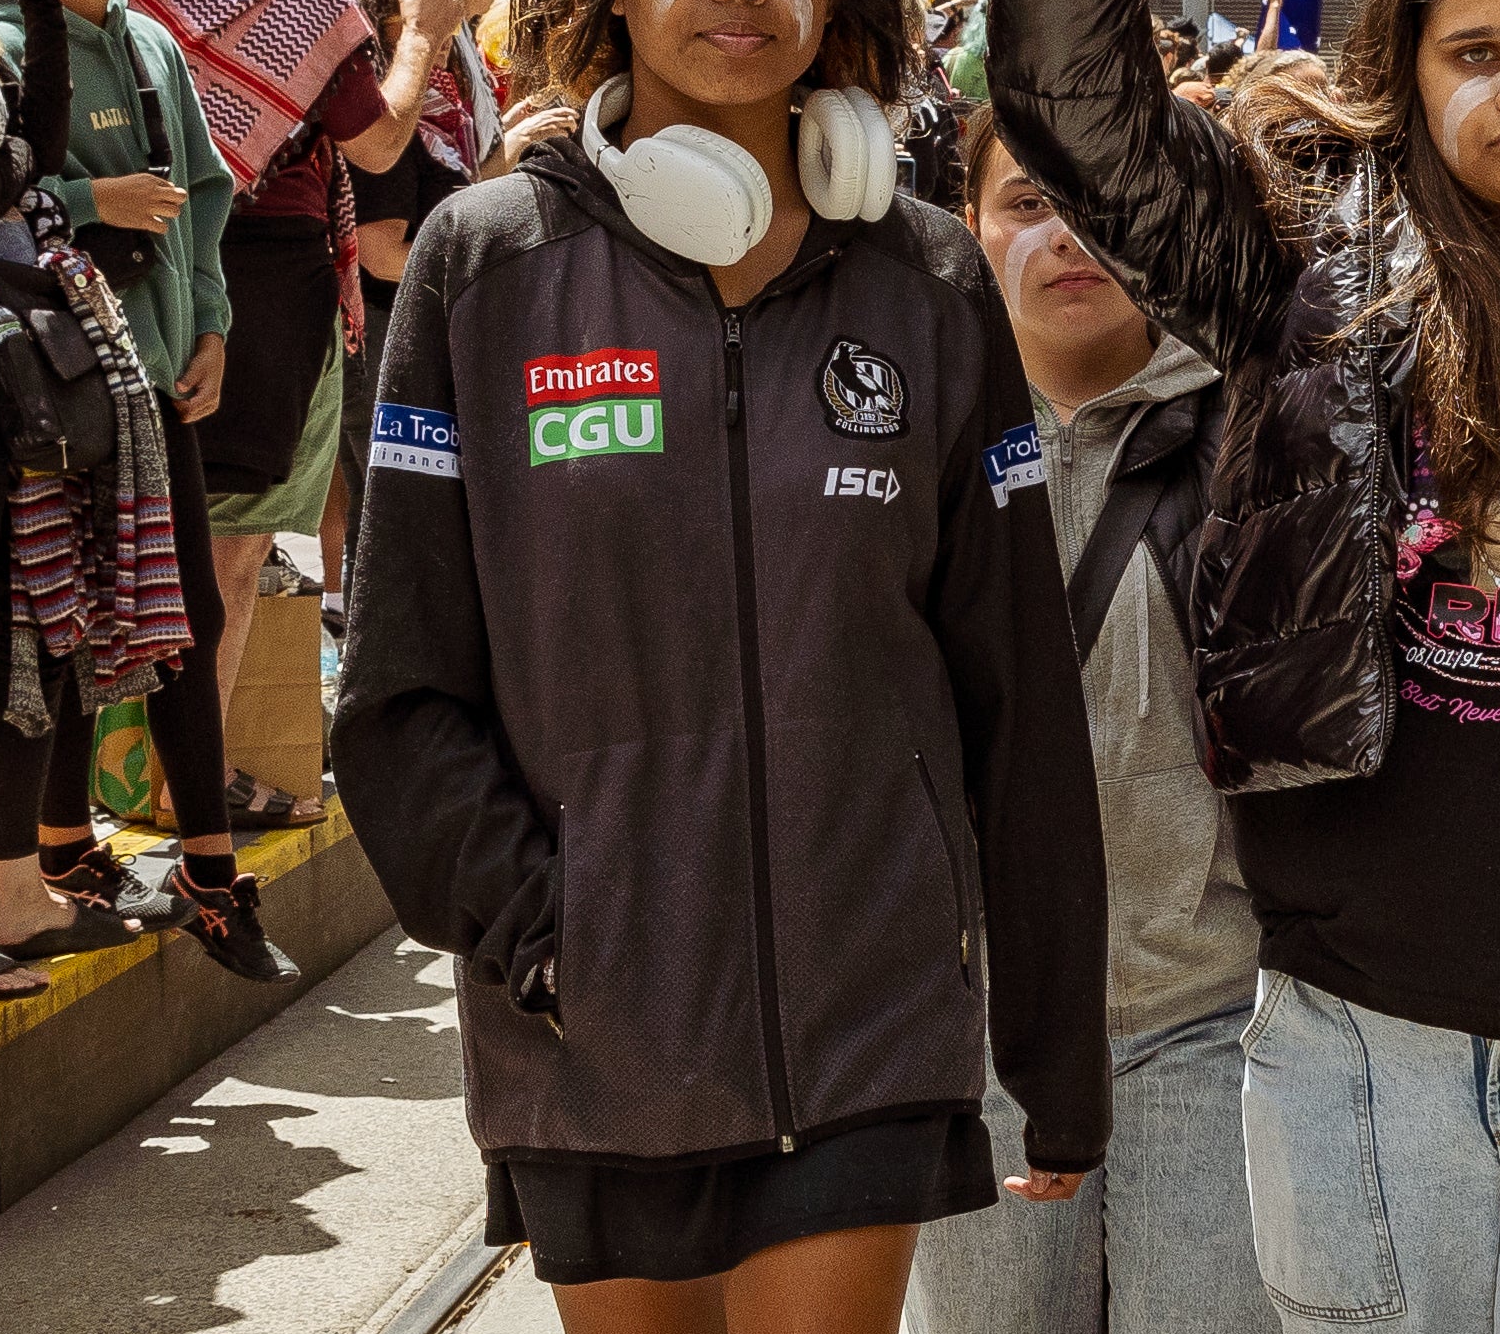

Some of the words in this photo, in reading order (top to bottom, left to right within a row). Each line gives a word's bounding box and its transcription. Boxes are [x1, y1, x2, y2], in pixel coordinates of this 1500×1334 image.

[530, 358, 654, 394] Emirates
[376, 411, 403, 438] La
[534, 404, 656, 457] CGU
[1405, 646, 1483, 669] 08/01/91
[1400, 679, 1446, 711] But
